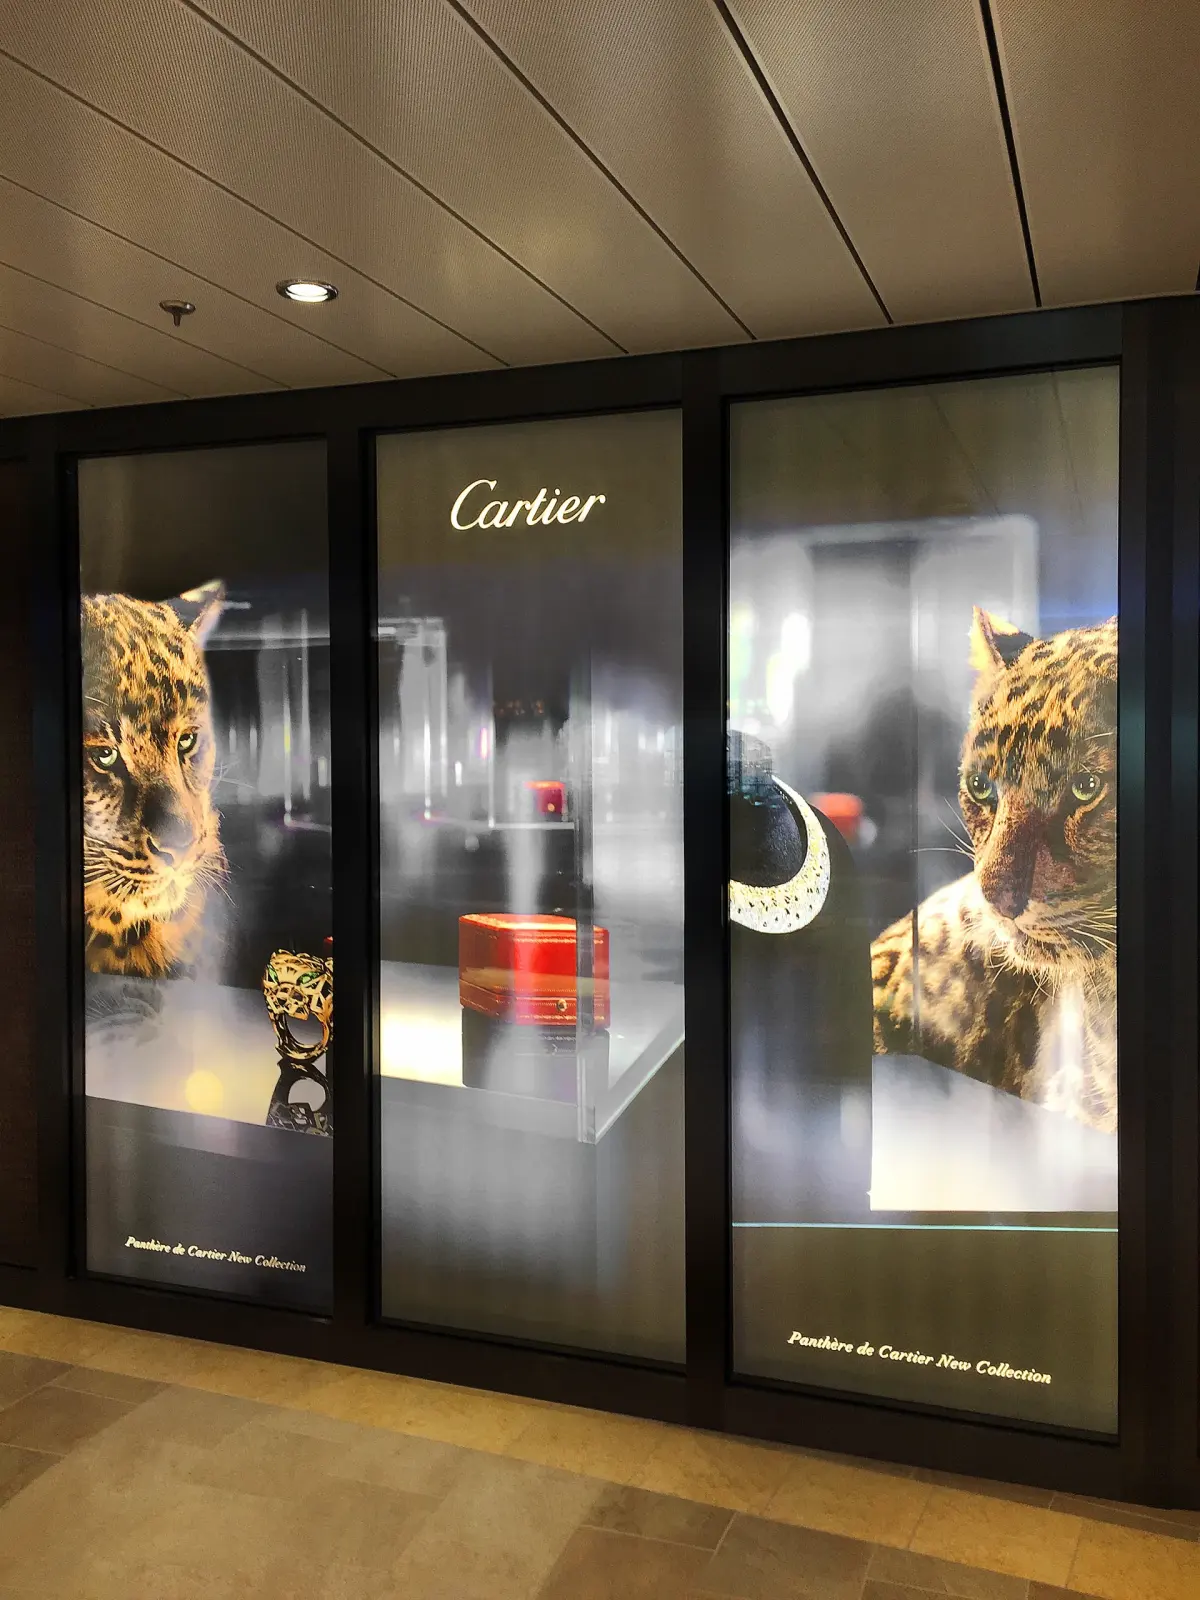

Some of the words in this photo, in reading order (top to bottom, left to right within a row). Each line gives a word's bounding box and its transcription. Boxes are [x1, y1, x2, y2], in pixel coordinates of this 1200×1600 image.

[450, 479, 607, 531] Cartier
[124, 1235, 171, 1254] Panthère
[172, 1242, 186, 1256] de
[187, 1245, 228, 1262] Cartier
[227, 1250, 253, 1265] New
[254, 1254, 307, 1273] Collection
[787, 1330, 854, 1353] Panthère
[856, 1341, 875, 1357] de
[878, 1345, 935, 1367] Cartier
[935, 1353, 972, 1372] New
[975, 1359, 1052, 1385] Collection
